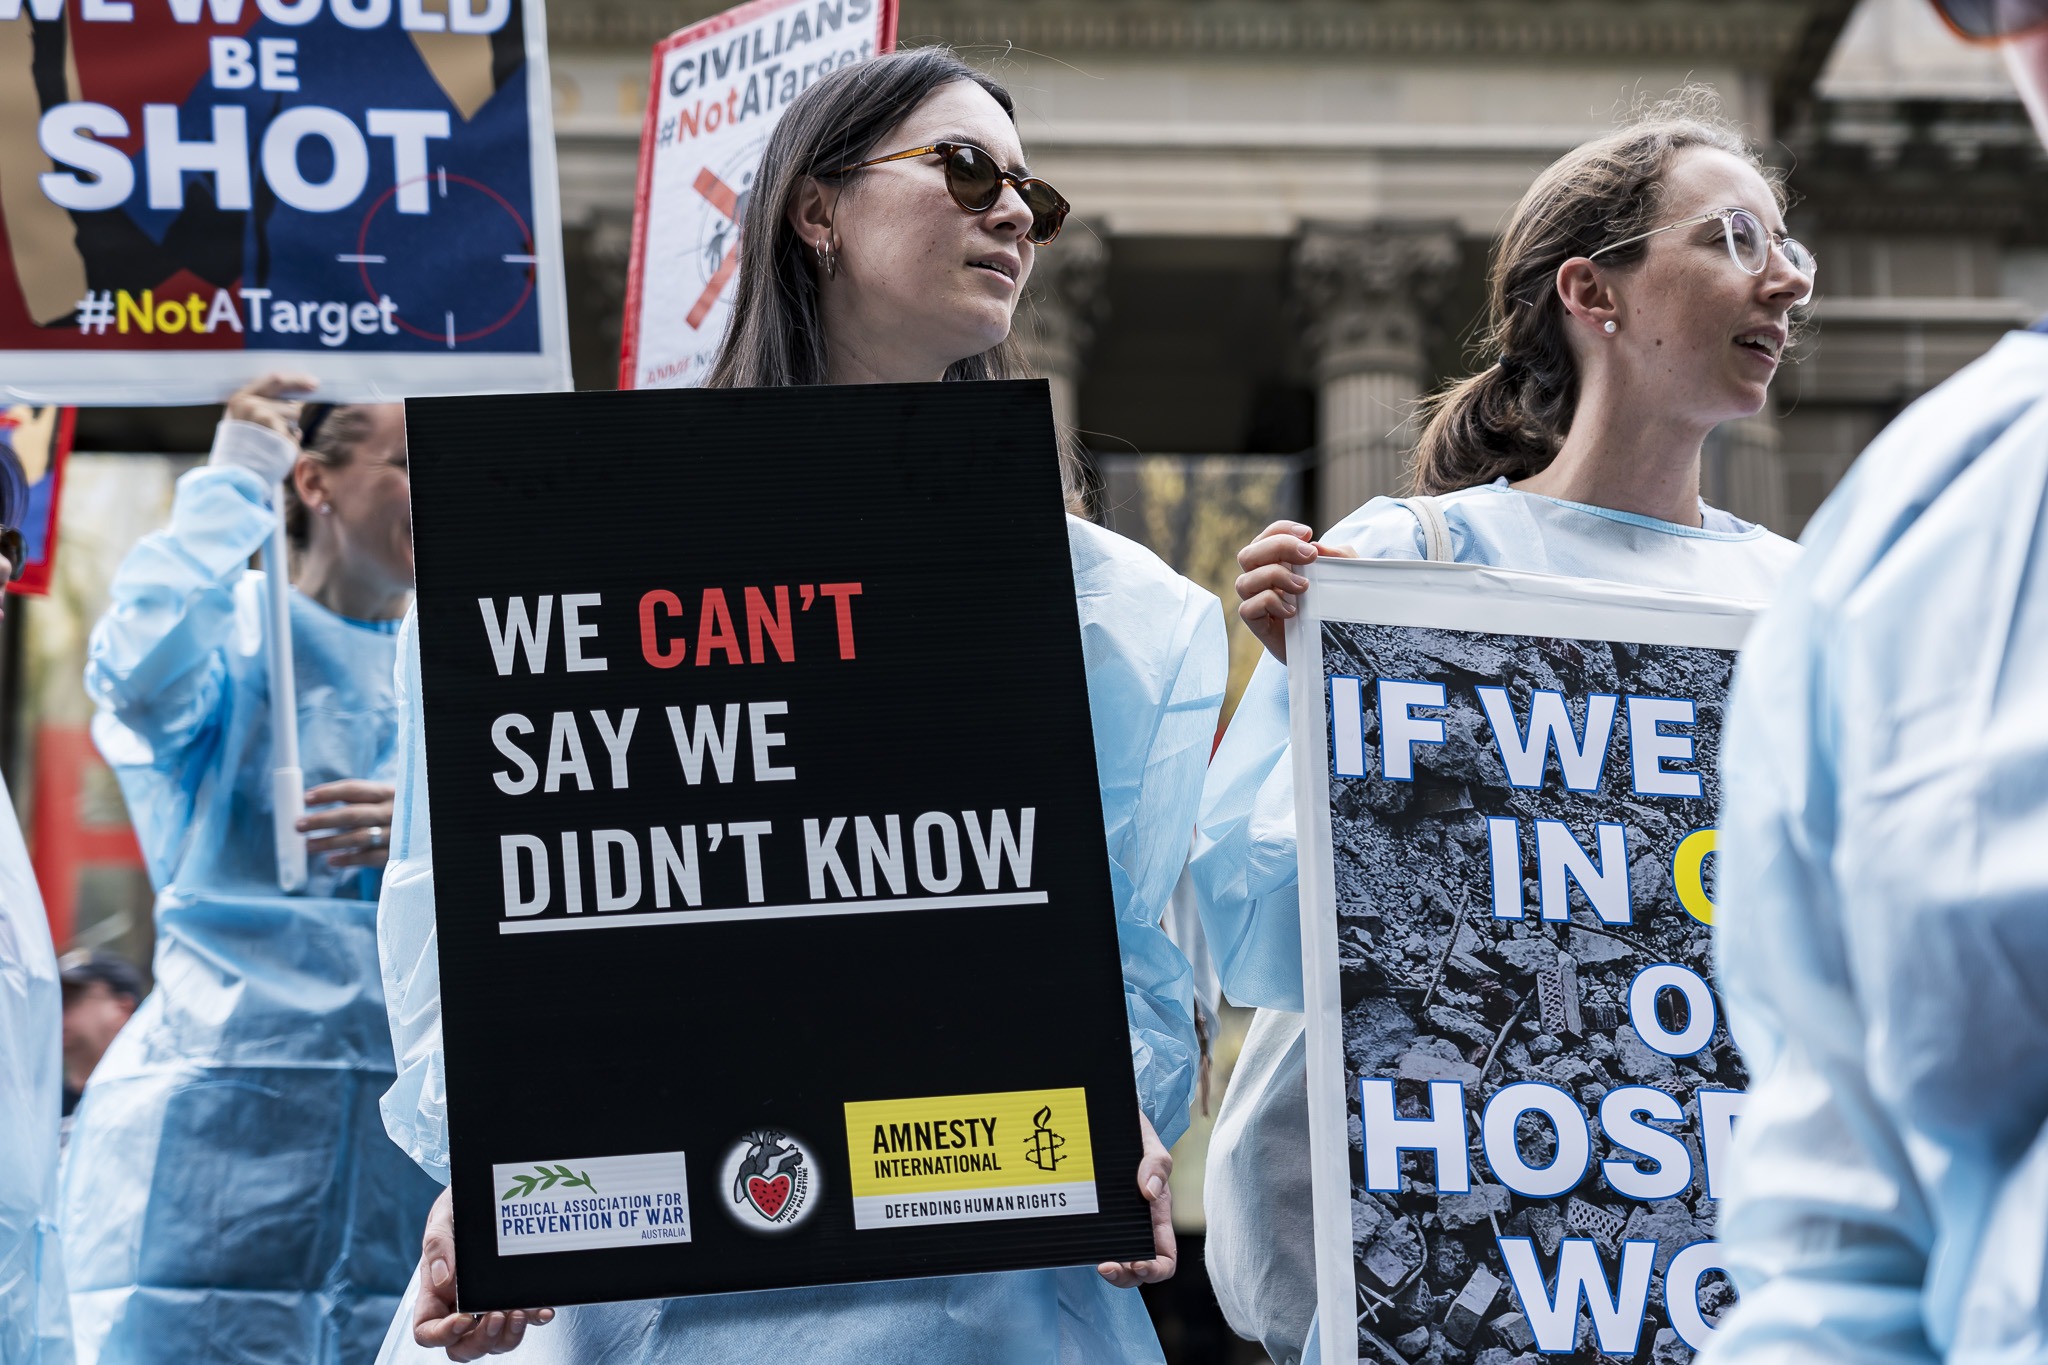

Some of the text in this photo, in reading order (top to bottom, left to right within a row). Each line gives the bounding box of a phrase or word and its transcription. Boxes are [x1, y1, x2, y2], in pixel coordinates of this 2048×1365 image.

[209, 36, 300, 91] BE
[669, 0, 872, 97] CIVILIANS
[38, 101, 452, 214] SHOT
[76, 288, 399, 346] #NotATarget
[478, 582, 863, 676] WE CAN’T
[490, 701, 796, 796] SAY WE
[1330, 674, 1703, 798] IF WE
[500, 807, 1036, 918] DIDN’T KNOW
[1486, 816, 1632, 926] IN
[873, 1117, 998, 1154] AMNESTY
[874, 1152, 1002, 1179] INTERNATIONAL
[501, 1192, 682, 1218] MEDICAL ASSOCIATION FOR
[503, 1207, 685, 1237] PREVENTION OF WAR
[786, 1167, 808, 1224] FOR PALESTINE
[885, 1192, 1067, 1219] DEFENDING HUMAN RIGHTS
[641, 1227, 687, 1240] AUSTRALIA
